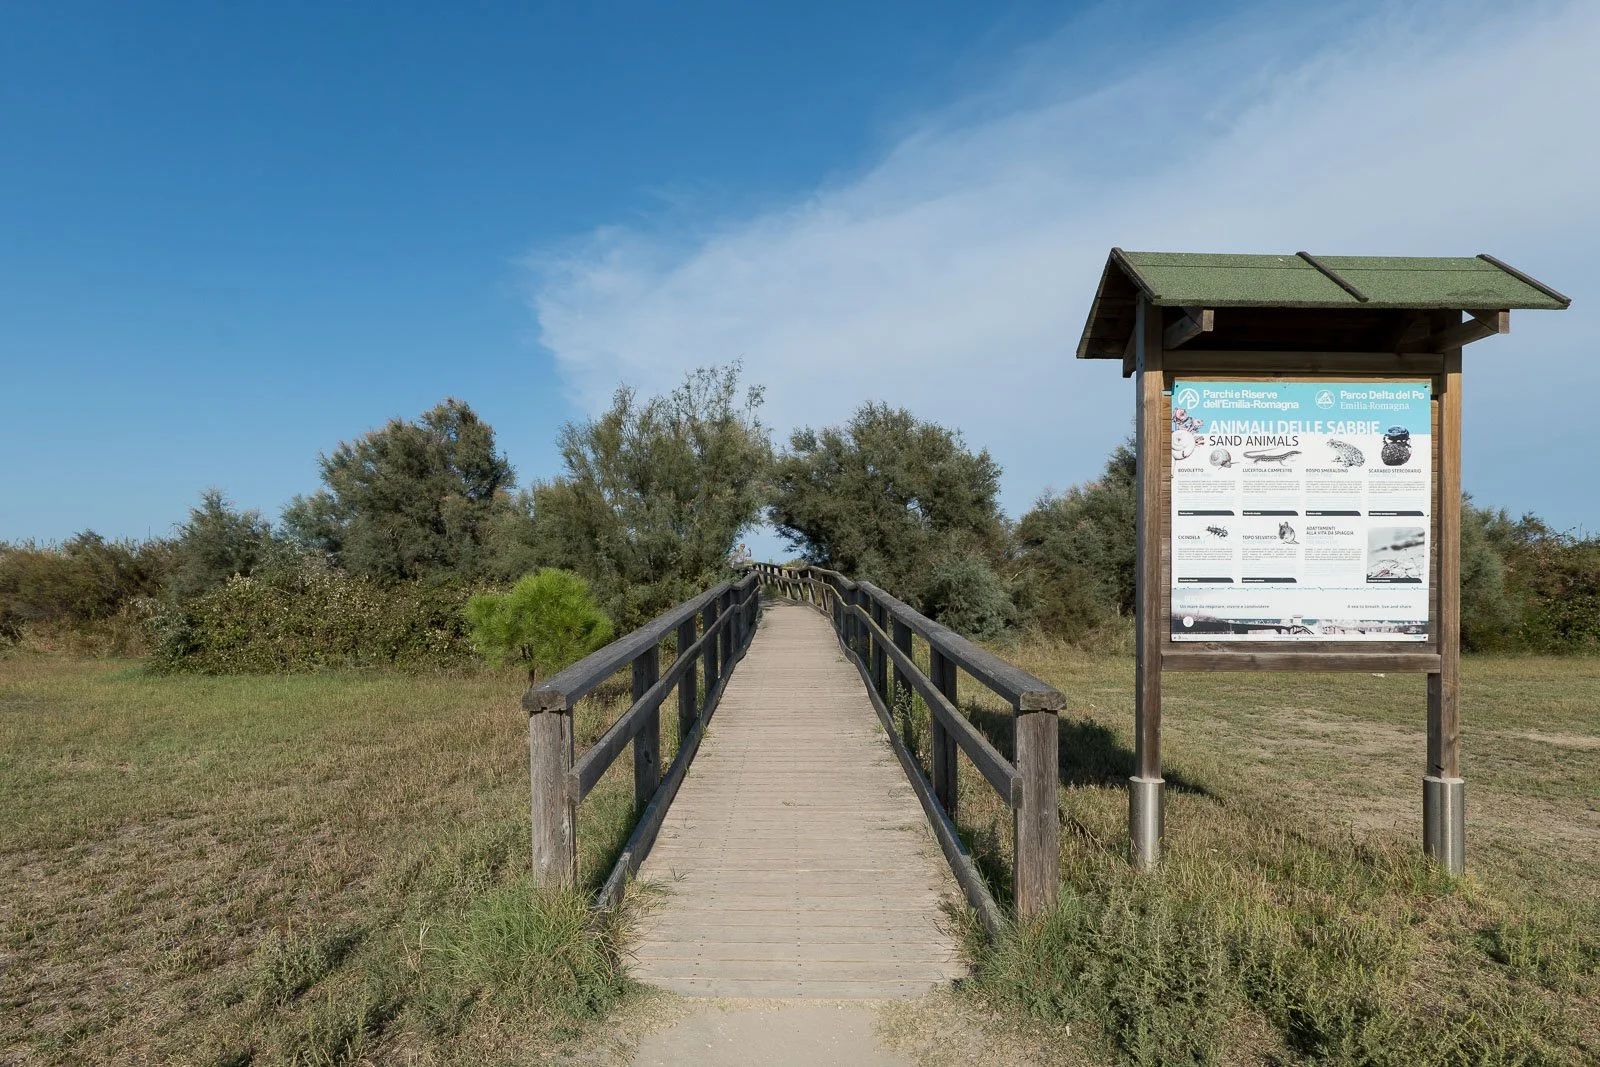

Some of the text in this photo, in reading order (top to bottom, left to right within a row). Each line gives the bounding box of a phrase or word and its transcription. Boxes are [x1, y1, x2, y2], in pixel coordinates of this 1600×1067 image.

[1203, 389, 1278, 399] Parchi e Riserve
[1340, 390, 1424, 400] Parco Delta del Po
[1203, 399, 1299, 411] dell'Emilia-Romagna
[1340, 401, 1410, 411] Emilia-Romagna
[1209, 420, 1380, 435] ANIMALI DELLE SABBIE
[1209, 435, 1299, 446] SAND ANIMALS
